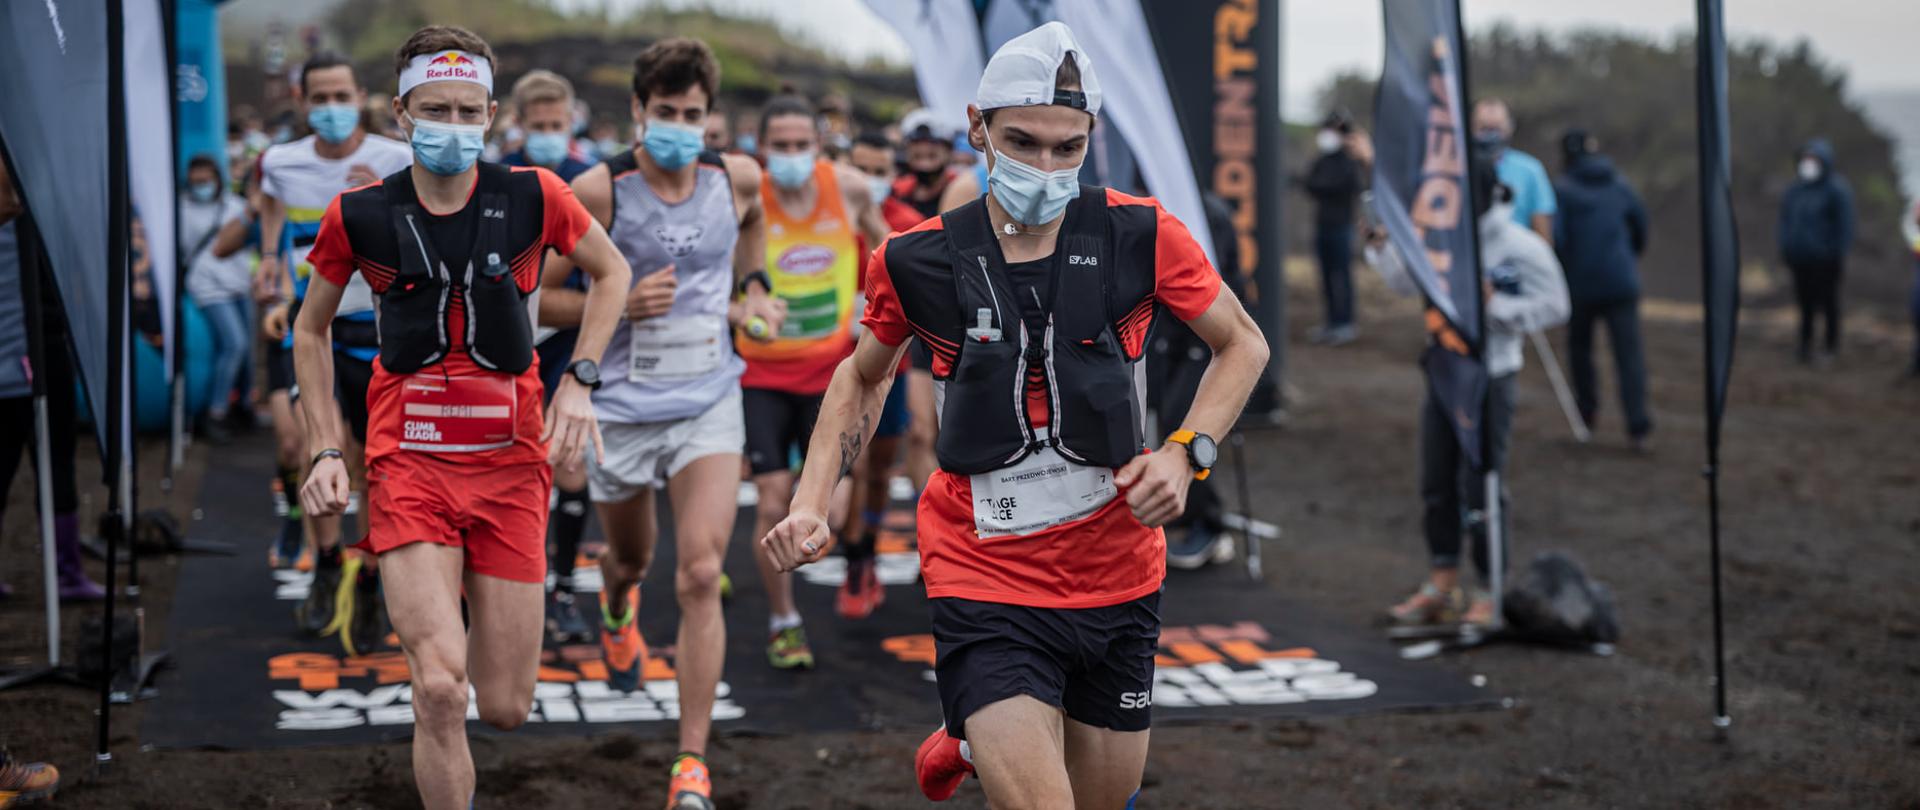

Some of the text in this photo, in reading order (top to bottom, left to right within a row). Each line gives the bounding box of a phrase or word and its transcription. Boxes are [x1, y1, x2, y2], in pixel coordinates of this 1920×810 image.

[426, 68, 478, 79] Red Bull
[404, 421, 436, 432] CLIMB
[404, 430, 443, 441] LEADER
[1100, 474, 1106, 484] 7
[981, 509, 1013, 522] CE
